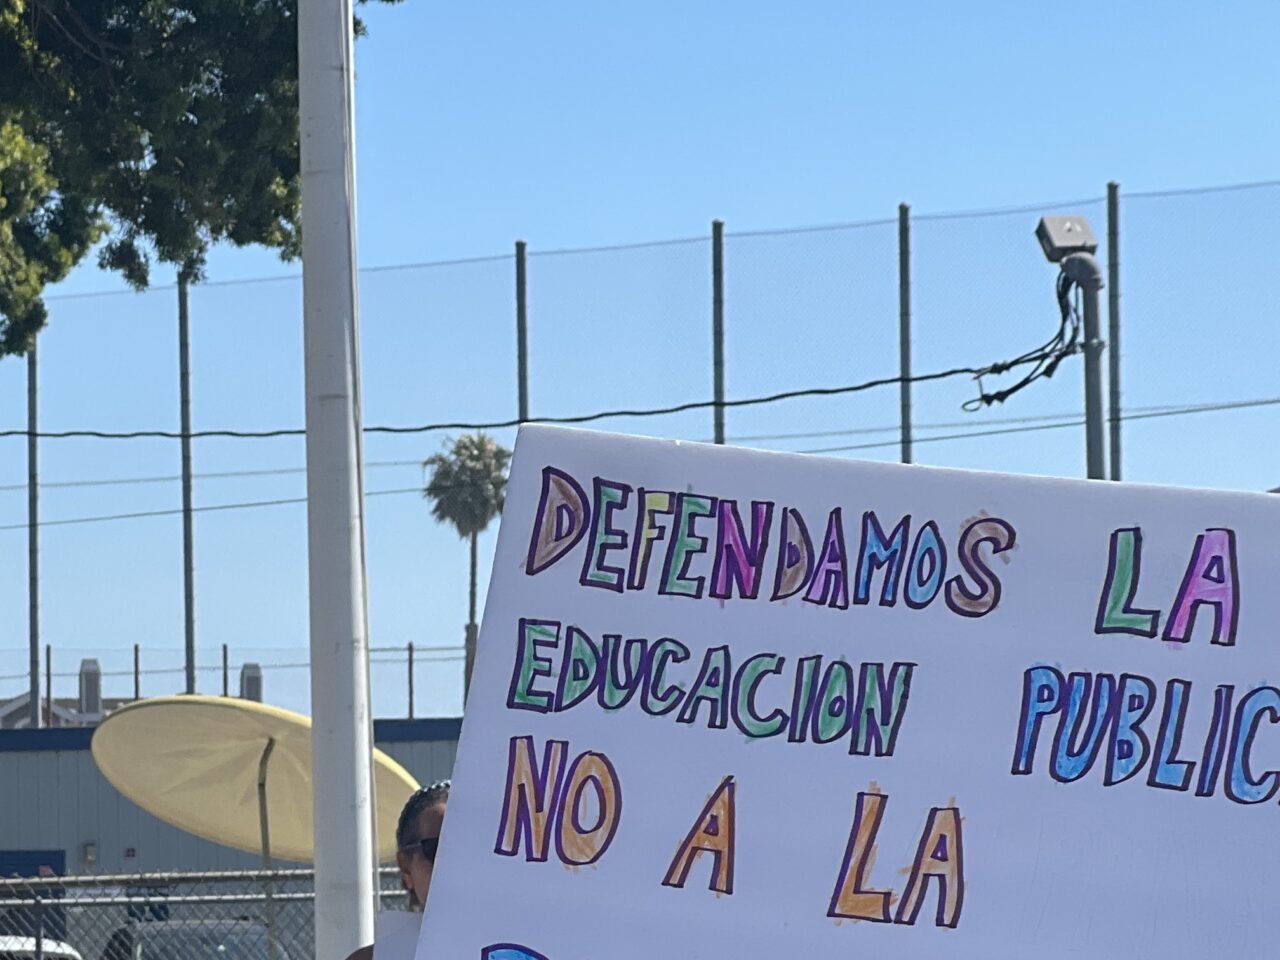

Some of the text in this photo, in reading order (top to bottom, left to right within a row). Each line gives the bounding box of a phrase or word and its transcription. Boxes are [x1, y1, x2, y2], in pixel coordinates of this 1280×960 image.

[526, 465, 1241, 647] DEFENDAMOS LA
[506, 617, 1280, 806] EDUCACION PUBLIC
[493, 735, 965, 929] NO A LA
